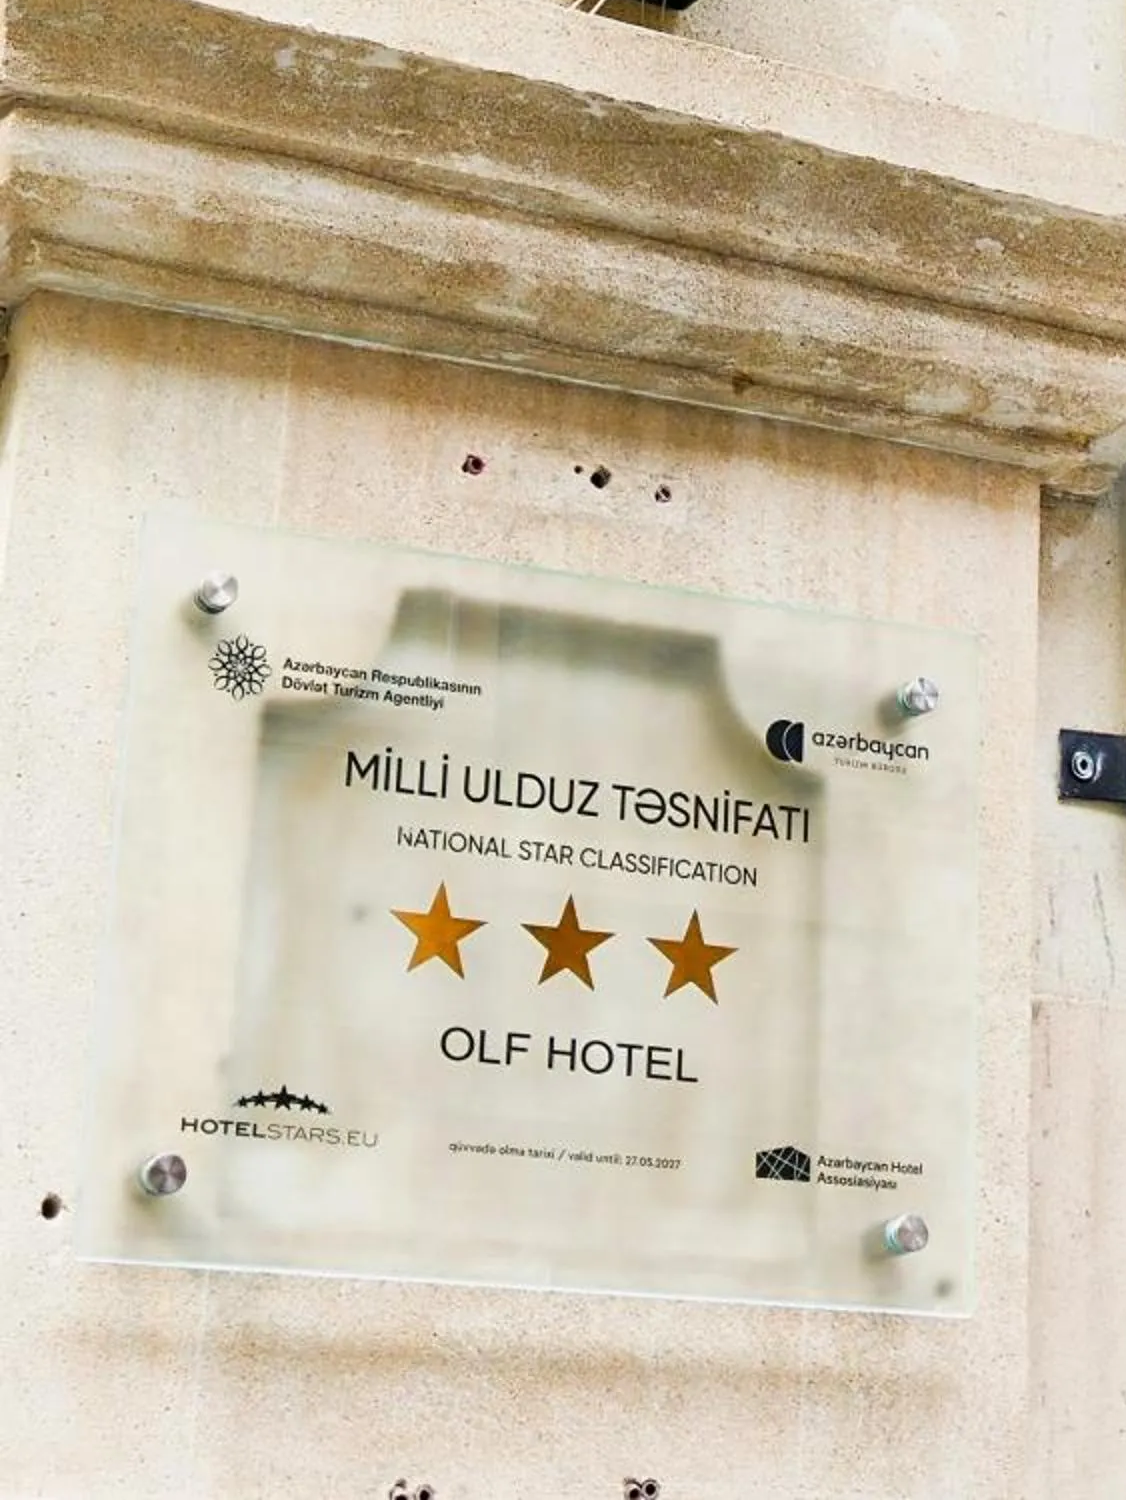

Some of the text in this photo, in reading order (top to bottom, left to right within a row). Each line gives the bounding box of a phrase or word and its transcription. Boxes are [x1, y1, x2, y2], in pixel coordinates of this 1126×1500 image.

[283, 657, 481, 696] Azərbaycan Respublikasının
[333, 682, 379, 701] Turizm
[383, 690, 444, 710] Agentliyi
[812, 732, 929, 761] azərbaycan
[345, 746, 810, 843] MİLLİ ULDUZ TƏSNİFATI
[397, 825, 758, 887] NATIONAL STAR CLASSIFICATION
[440, 1027, 699, 1082] OLF HOTEL
[181, 1117, 379, 1148] HOTELSTARS.EU
[568, 1150, 593, 1163] valid
[891, 1162, 923, 1176] Hotel
